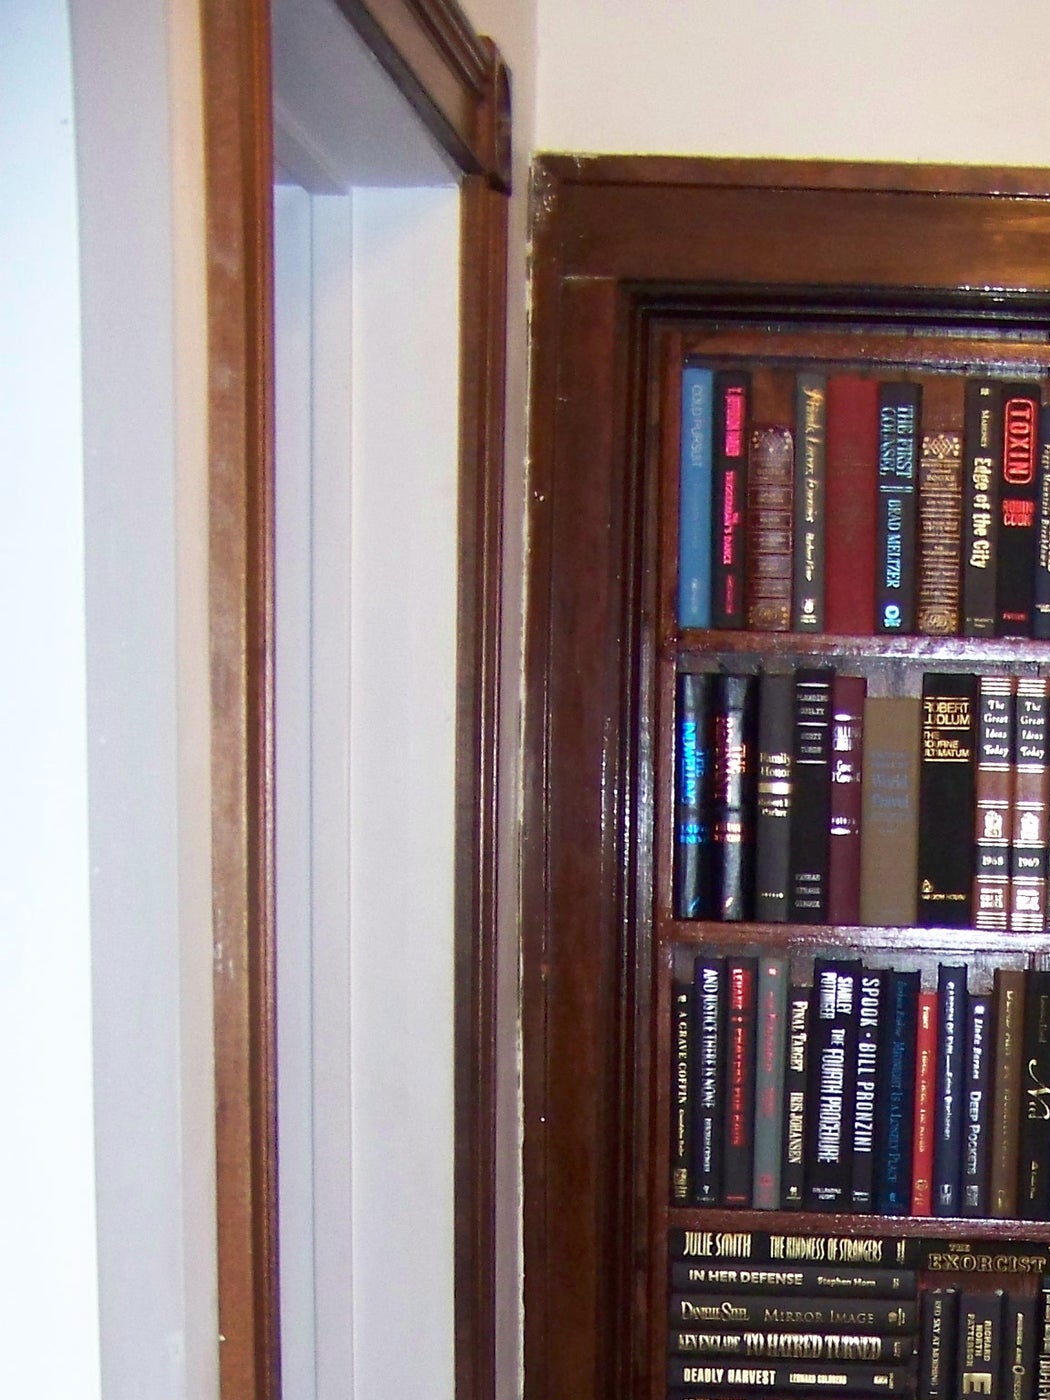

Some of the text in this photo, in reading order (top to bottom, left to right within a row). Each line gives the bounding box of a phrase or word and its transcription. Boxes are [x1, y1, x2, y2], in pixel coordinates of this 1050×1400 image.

[895, 405, 914, 478] THE FIRST
[1008, 409, 1031, 475] TOXIN
[969, 457, 993, 569] Edge of the City
[885, 499, 902, 588] BRAD MELTZER
[982, 713, 1009, 725] Great
[986, 700, 1005, 711] The
[1019, 714, 1046, 725] Great
[1024, 700, 1042, 712] The
[985, 727, 1008, 740] Ideas
[1021, 728, 1045, 741] Ideas
[982, 742, 1010, 757] Today
[1018, 742, 1046, 758] Today
[760, 768, 791, 779] Honor
[819, 970, 837, 1020] POTTINGER
[836, 977, 853, 1015] STANLEY
[699, 968, 719, 1109] AND JUSTICE THERE IS NONE
[789, 1000, 809, 1073] FINAL TARGET
[676, 1011, 689, 1104] A GRAVE COFFIN
[853, 977, 880, 1154] SPOOK BILL PRONZINI
[817, 1028, 846, 1164] THE FOURTH PROCEDURE
[968, 1090, 983, 1122] DEEP
[788, 1091, 805, 1164] IRIS JOHANSEN
[682, 1231, 885, 1262] JULIE SMITH THE KINDNESS OF STRANGERS
[689, 1268, 805, 1286] IN HER DEFENSE
[927, 1253, 1048, 1274] EXORCIST
[763, 1307, 877, 1325] MIRROR IMAGE
[766, 1333, 824, 1359] HATRED
[932, 1318, 942, 1347] SKY AT
[965, 1313, 976, 1367] PATTERSON
[974, 1324, 984, 1357] NORTH
[982, 1320, 993, 1362] RICHARD
[683, 1367, 778, 1385] DEADLY HARVEST
